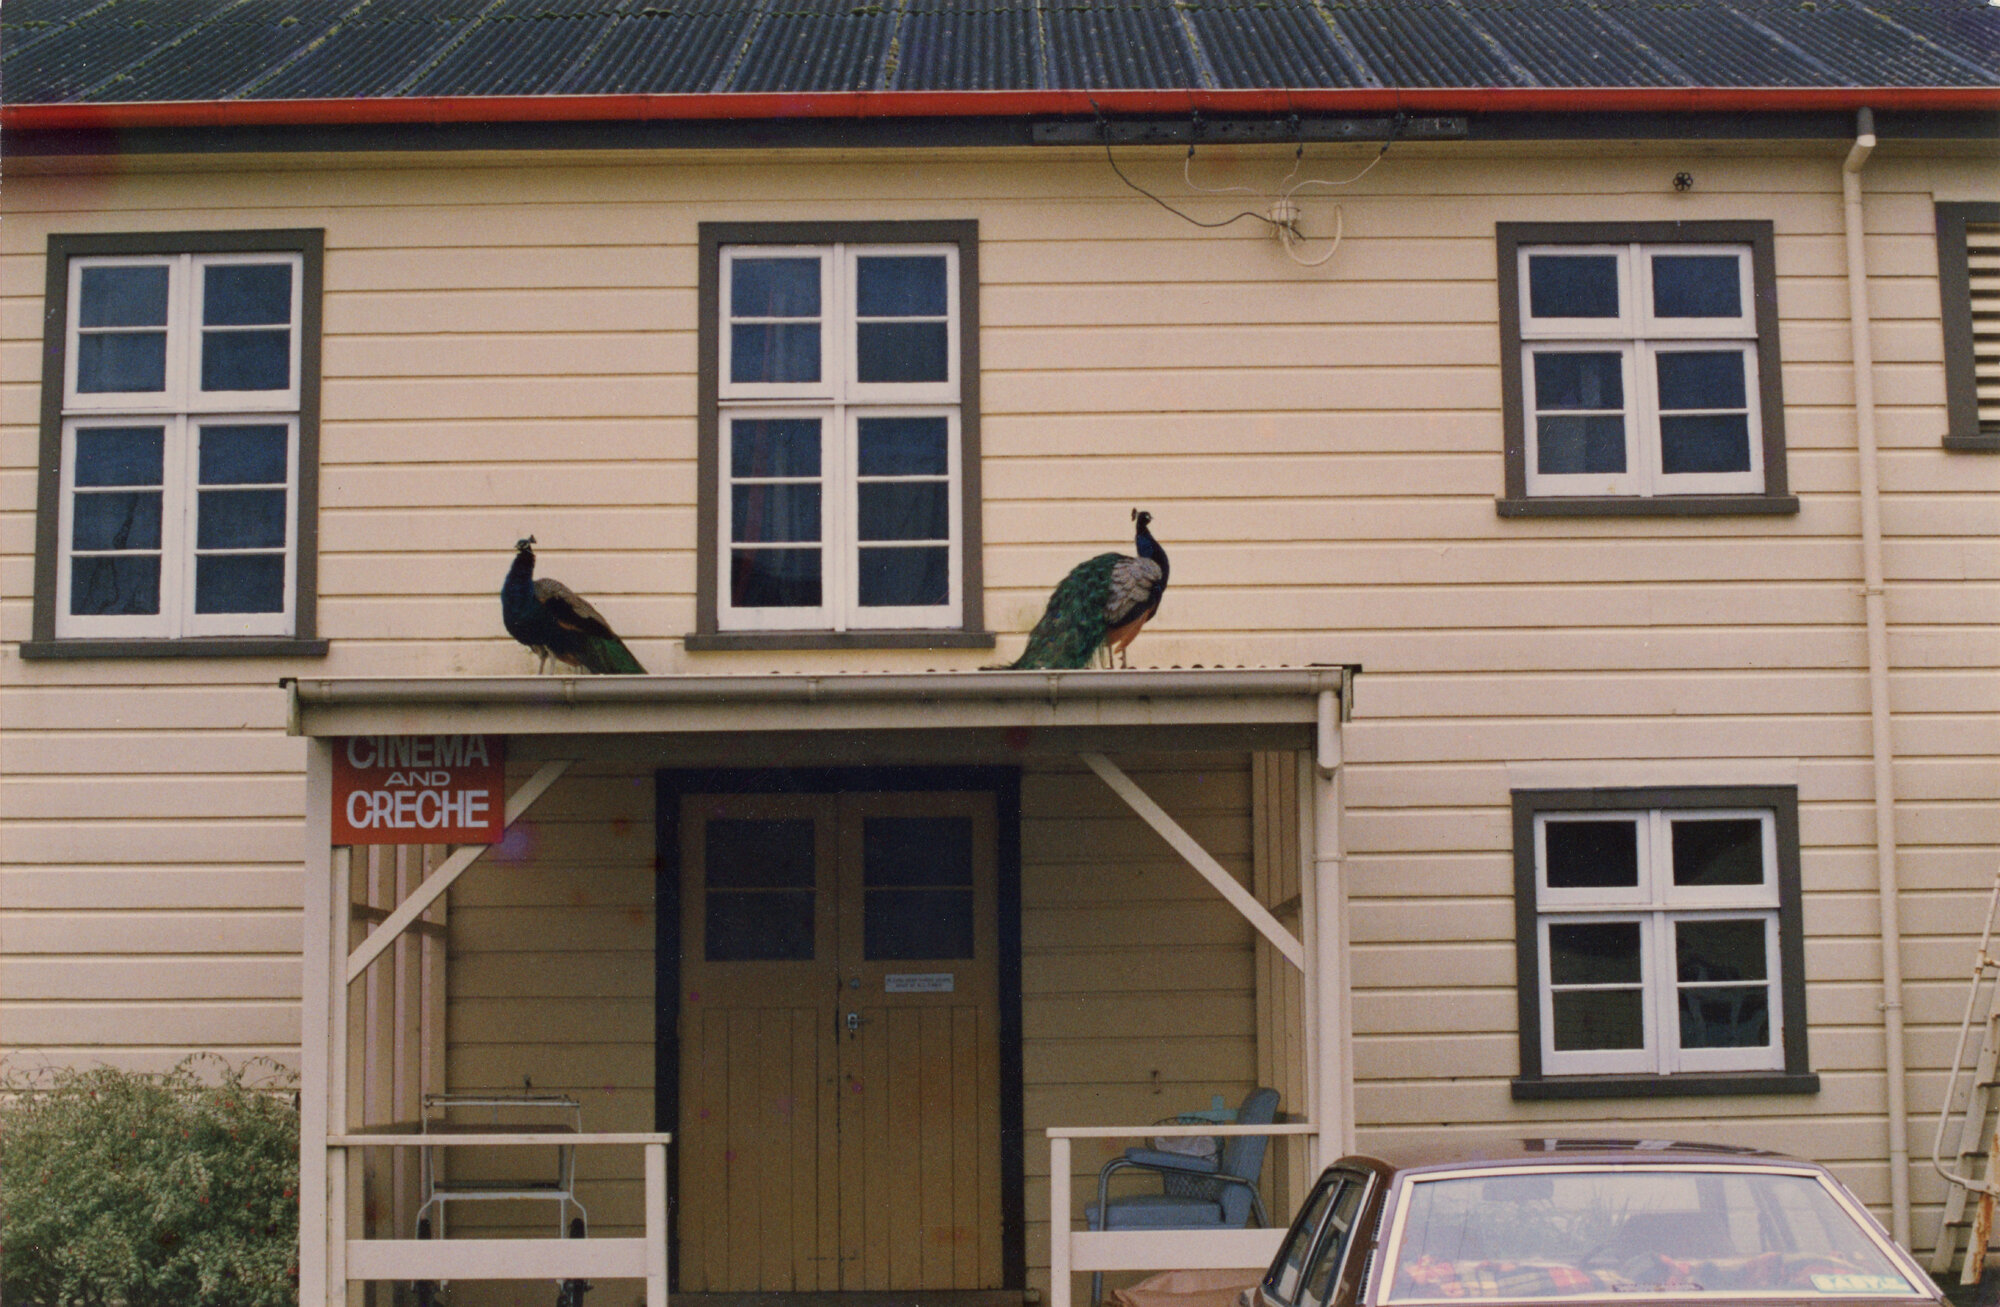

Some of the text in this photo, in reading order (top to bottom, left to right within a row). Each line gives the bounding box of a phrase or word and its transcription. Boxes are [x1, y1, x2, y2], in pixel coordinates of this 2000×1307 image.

[347, 734, 490, 769] CINEMA
[384, 771, 451, 787] AND
[346, 790, 489, 829] CRECHE
